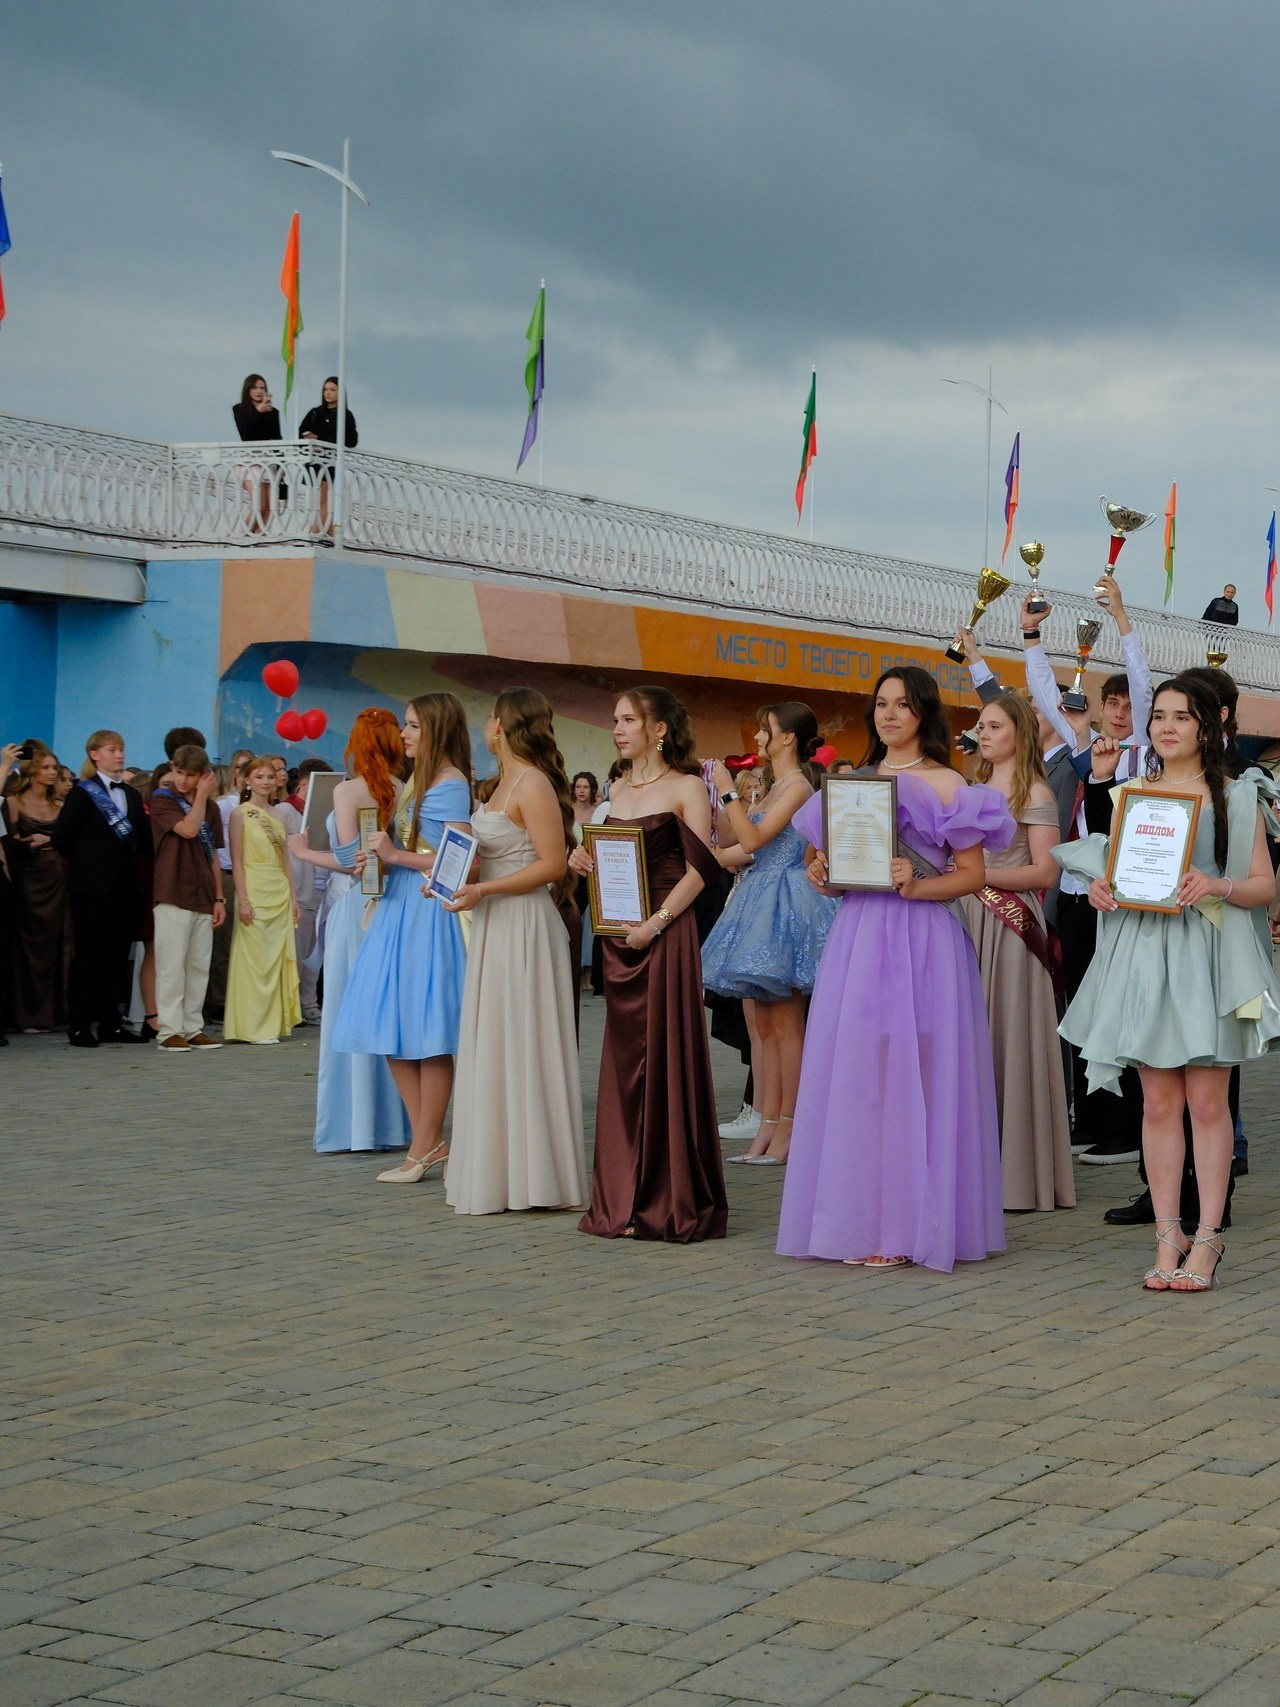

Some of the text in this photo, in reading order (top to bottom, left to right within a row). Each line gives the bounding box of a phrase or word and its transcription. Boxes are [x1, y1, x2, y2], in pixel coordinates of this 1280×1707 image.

[716, 631, 787, 669] МЕСТО
[798, 642, 871, 679] ТВОЕГО
[1135, 823, 1176, 838] ДИПЛОМ
